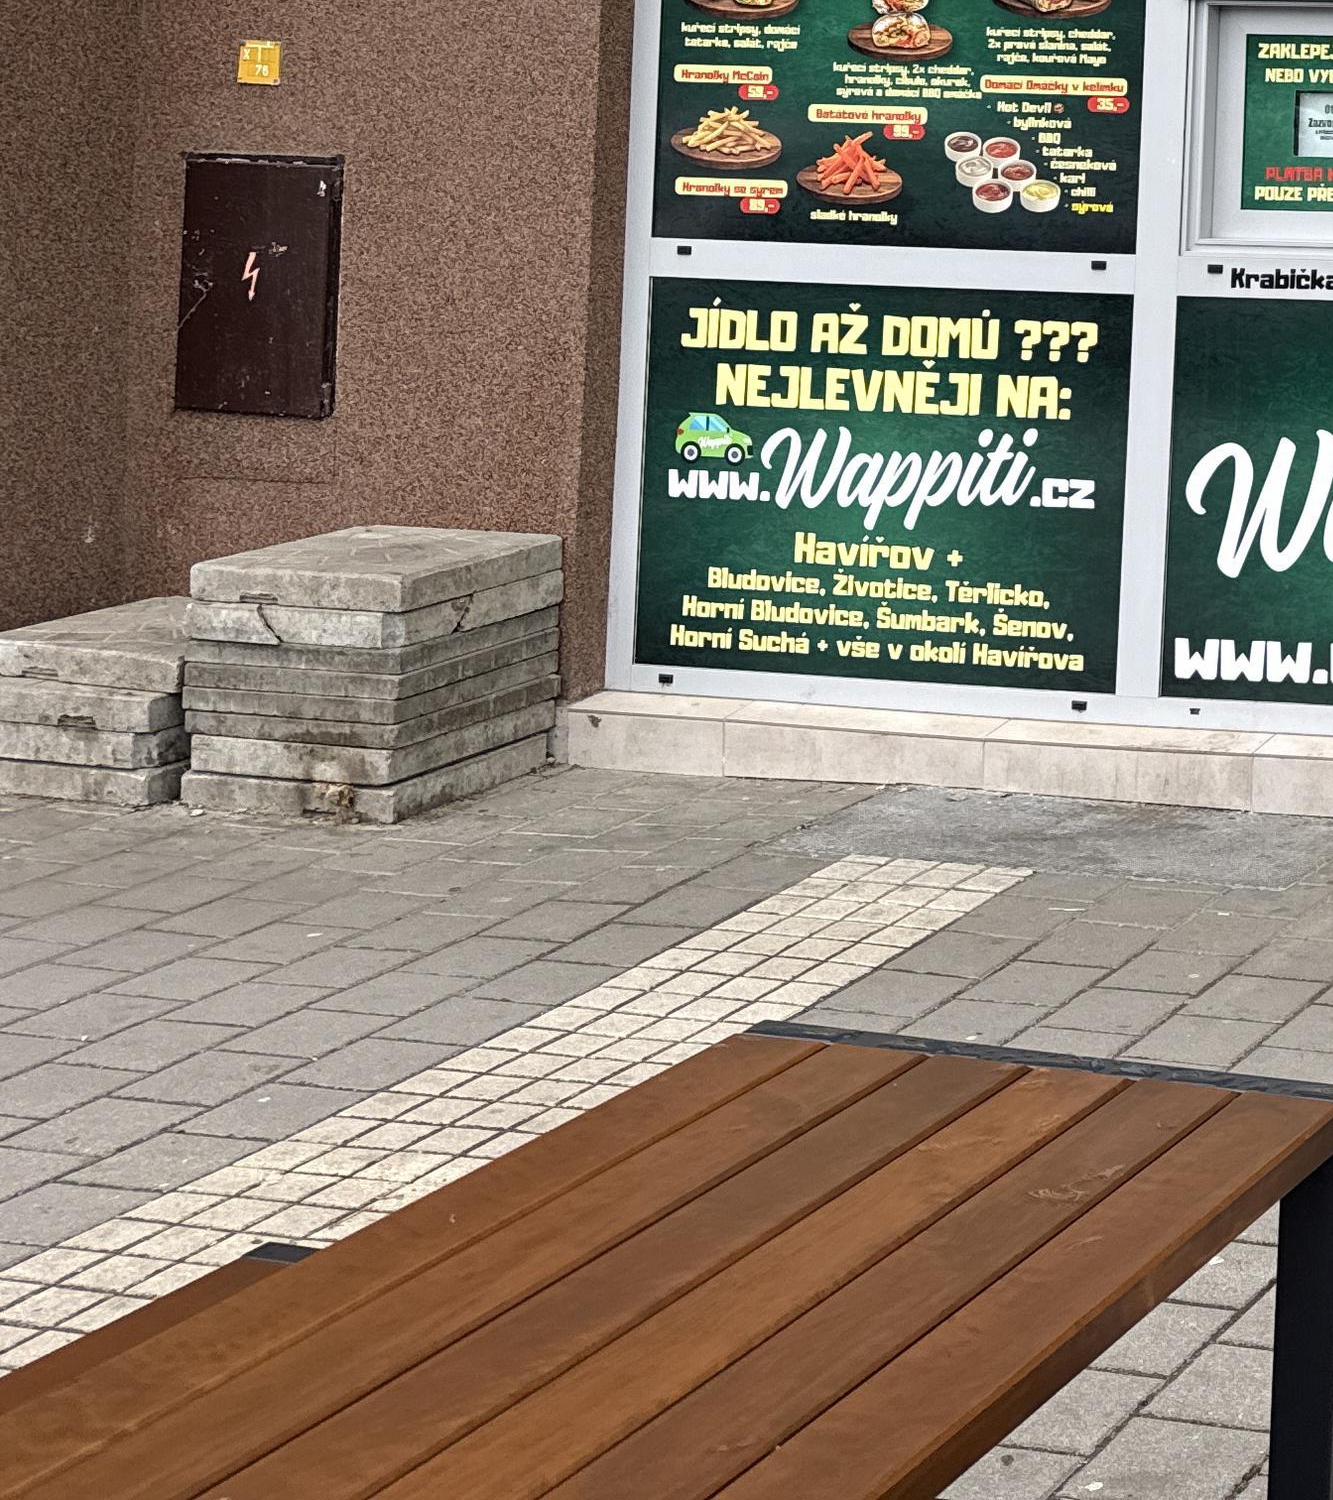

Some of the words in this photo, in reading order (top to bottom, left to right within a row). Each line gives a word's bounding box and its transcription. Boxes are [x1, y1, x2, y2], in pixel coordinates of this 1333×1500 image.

[1265, 68, 1304, 83] NEBO
[1255, 186, 1303, 201] POUZE
[681, 297, 799, 353] JÍDLO
[810, 302, 869, 356] AŽ
[881, 309, 1001, 361] DOMŮ
[1014, 319, 1099, 363] ???
[715, 360, 982, 417] NEJLEVNĚJI
[996, 374, 1073, 420] NA:
[794, 531, 935, 570] Havířov
[947, 549, 964, 568] +
[708, 566, 826, 596] Bludovice,
[832, 568, 938, 603] Životice,
[946, 578, 1051, 610] Těrlicko,
[682, 594, 744, 622] Horní
[750, 597, 870, 630] Bludovice,
[876, 600, 986, 637] Šumbark,
[993, 607, 1075, 642] Šenov,
[670, 624, 732, 651] Horní
[738, 629, 810, 656] Suchá
[817, 639, 828, 652] +
[837, 634, 880, 660] vše
[888, 644, 903, 661] v
[910, 641, 966, 665] okolí
[972, 643, 1085, 672] Havířova
